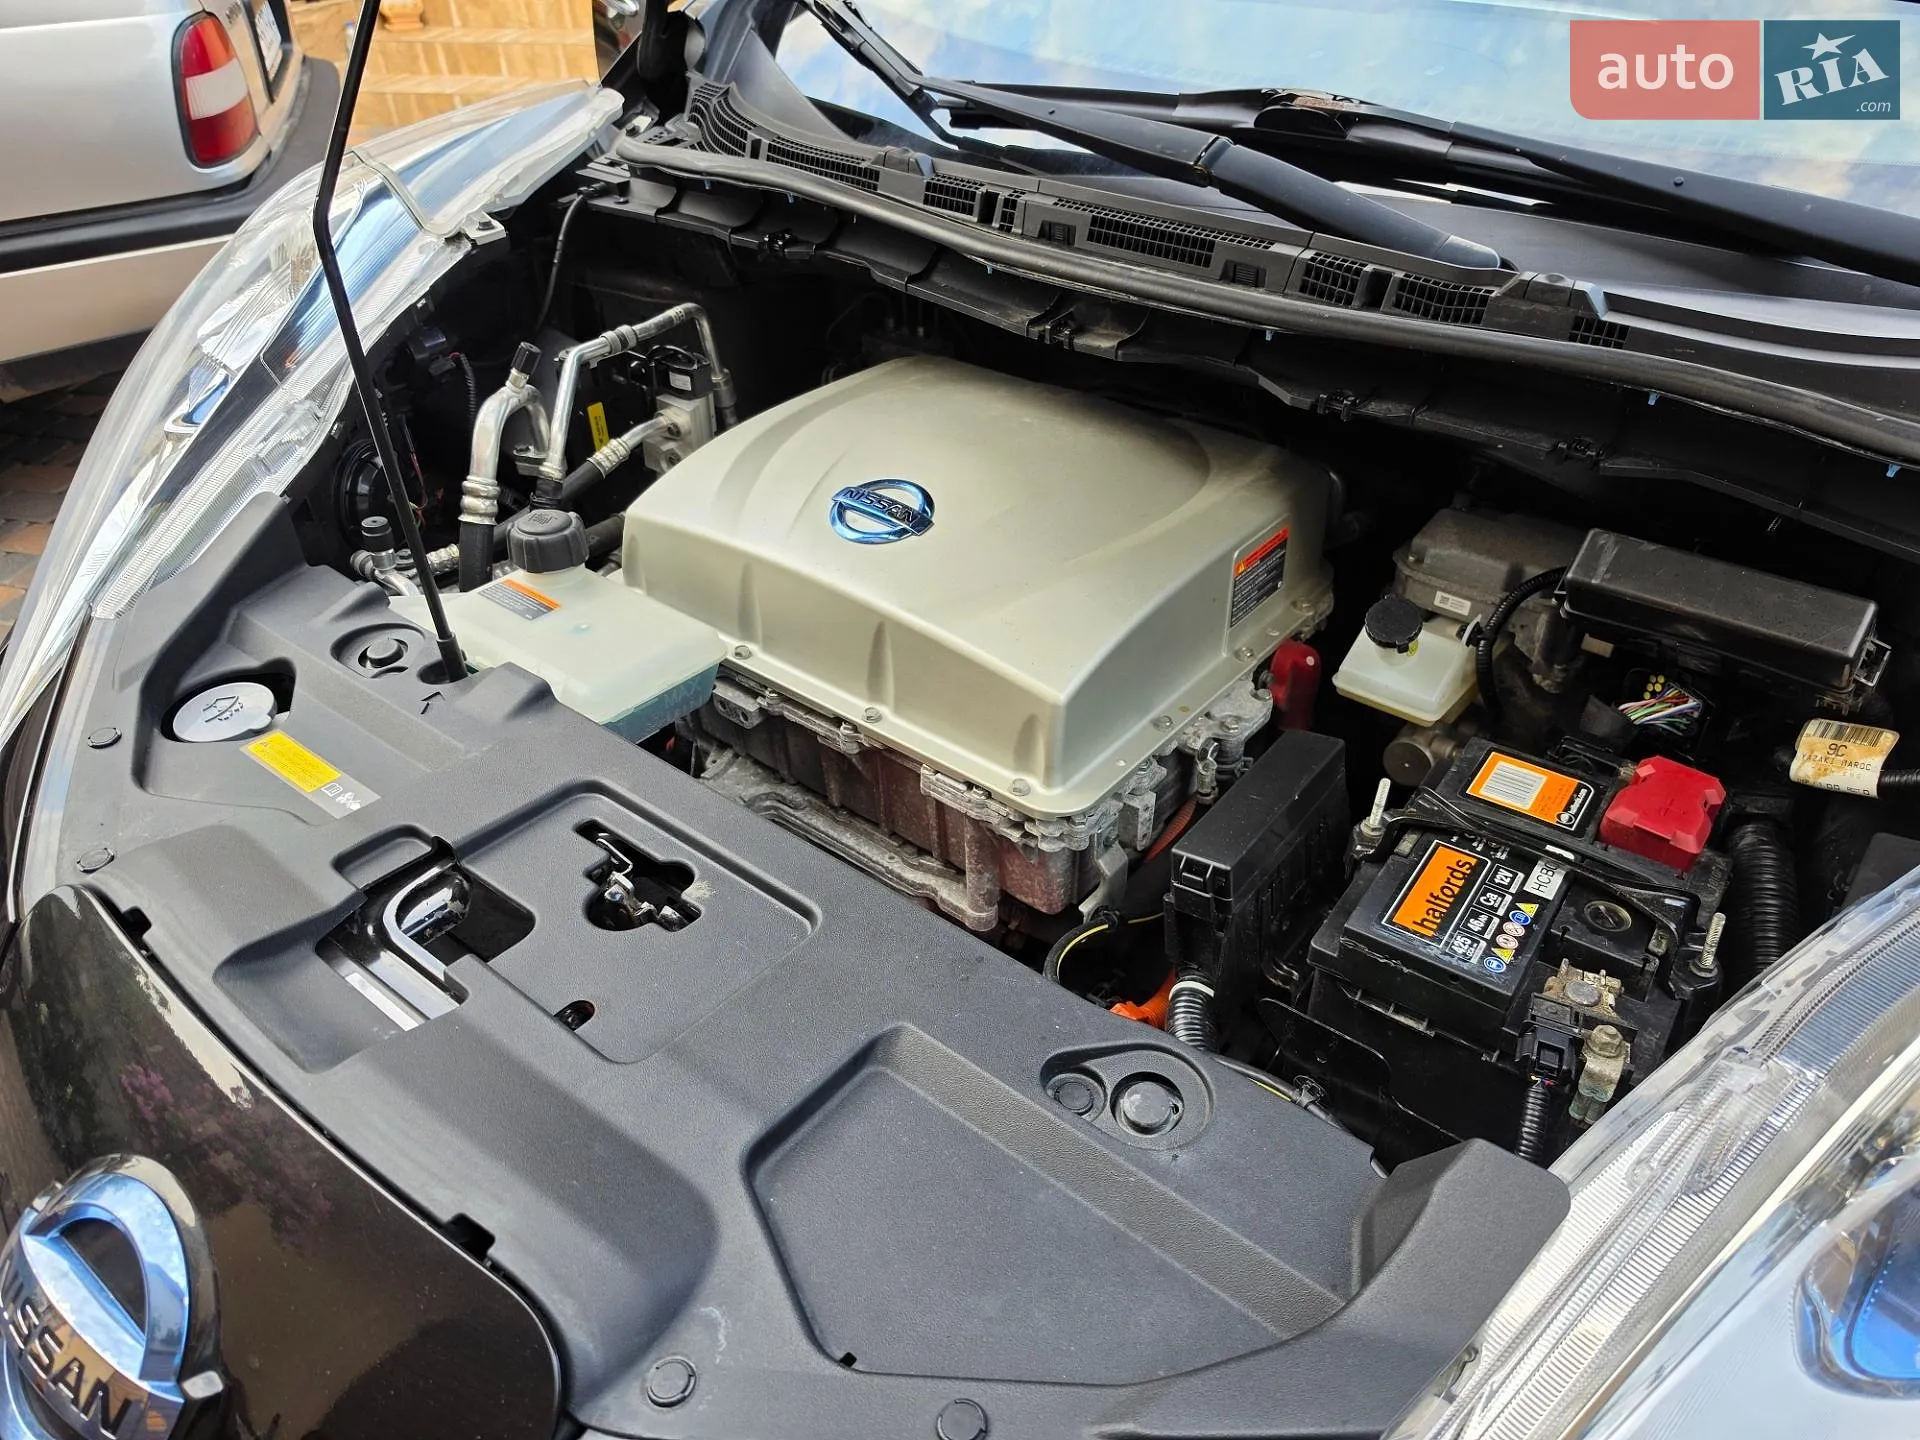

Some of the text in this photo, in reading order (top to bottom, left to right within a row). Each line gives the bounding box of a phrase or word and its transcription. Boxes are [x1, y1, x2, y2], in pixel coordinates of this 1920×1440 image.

[843, 488, 918, 527] NISSAN
[1827, 742, 1848, 758] 9C
[1494, 867, 1514, 886] 12V
[1411, 858, 1474, 939] halfords
[1480, 892, 1499, 907] Ca
[1451, 935, 1472, 955] 425
